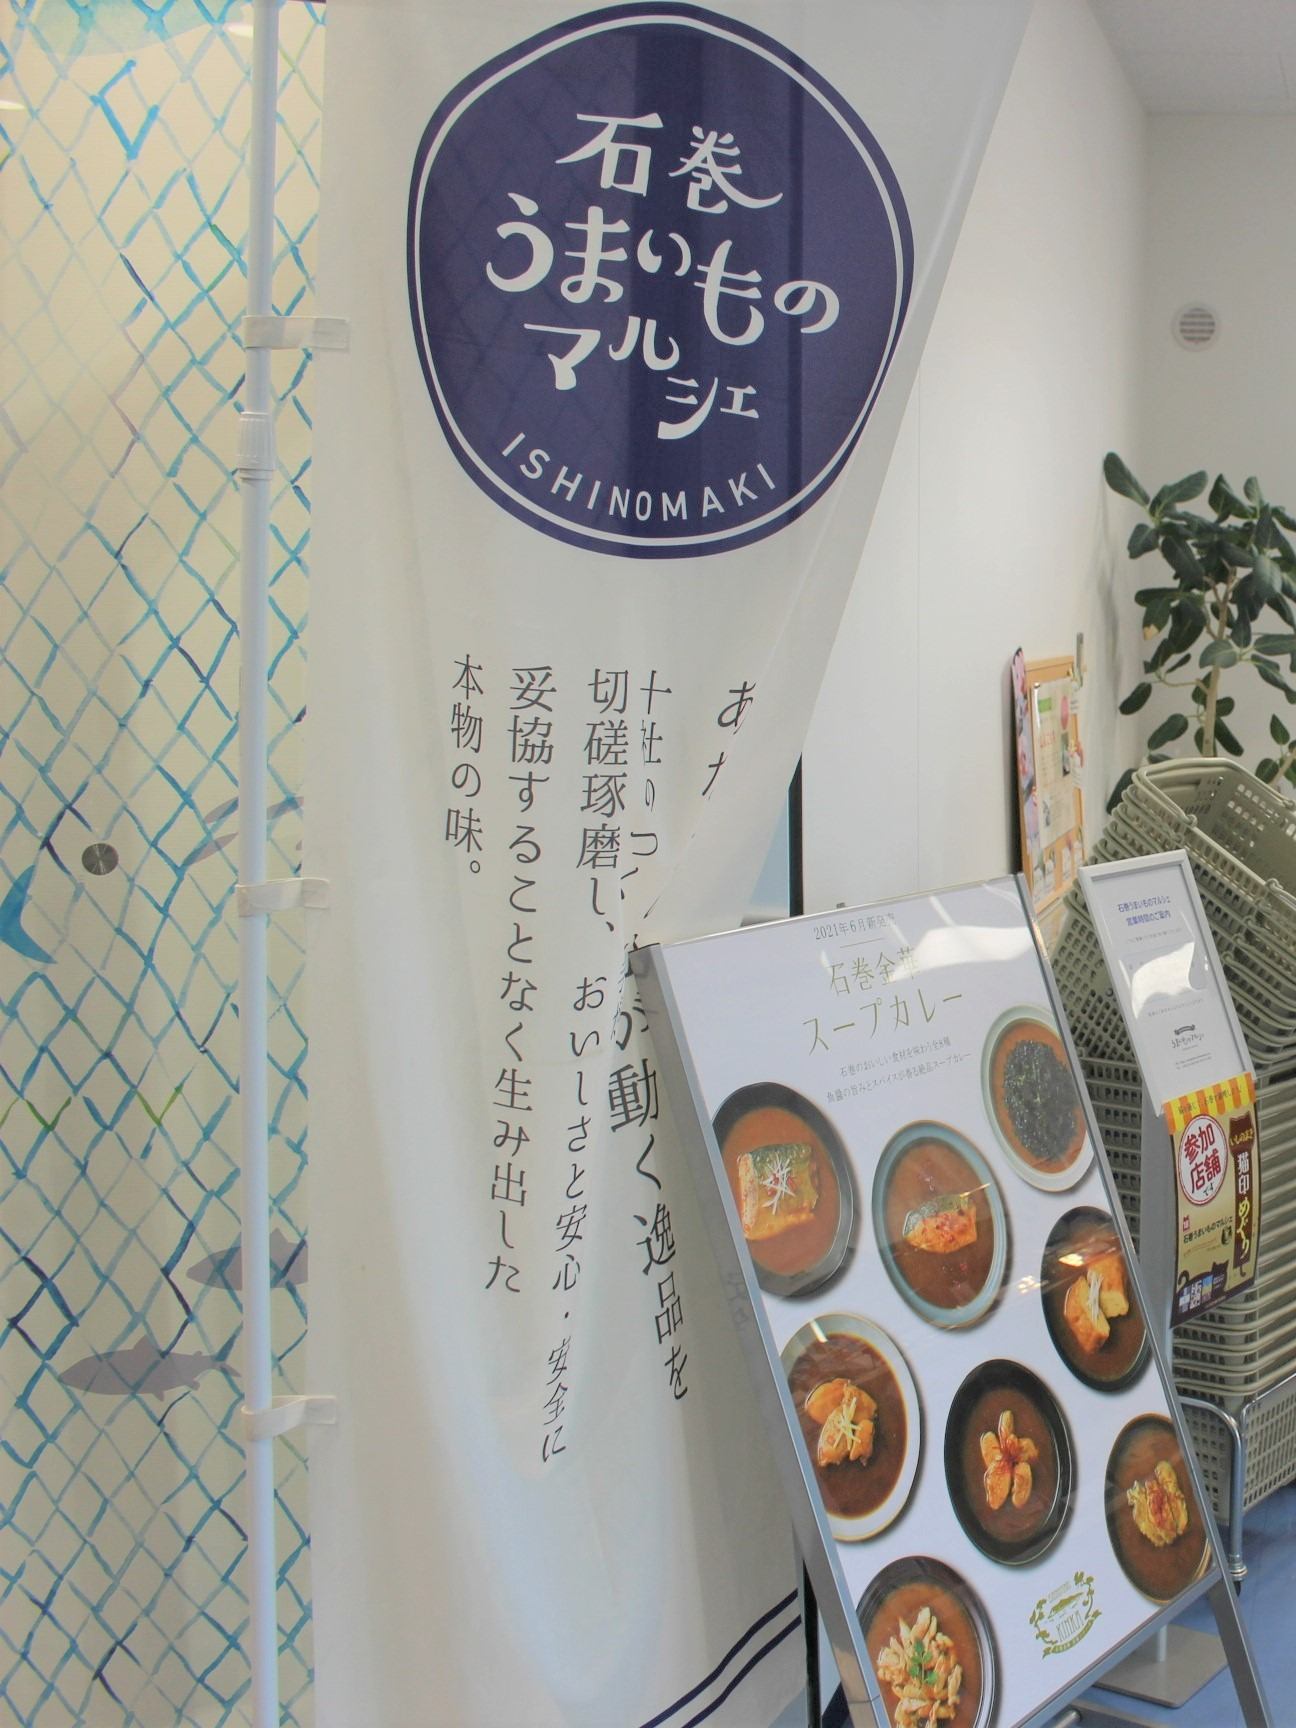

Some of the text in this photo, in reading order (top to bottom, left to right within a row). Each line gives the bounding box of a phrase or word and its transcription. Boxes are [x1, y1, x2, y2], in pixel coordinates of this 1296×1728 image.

[555, 111, 784, 214] 石巻
[484, 191, 841, 347] うまいもの
[523, 315, 760, 441] マルシェ
[501, 432, 778, 522] ISHINOMAKI
[444, 653, 484, 875] 本物の味。
[484, 665, 557, 1293] 妥協することなく生み出した
[802, 988, 963, 1056] スープカレー
[1184, 1123, 1215, 1165] 参加
[1190, 1147, 1222, 1194] 店舗
[1183, 1216, 1233, 1244] 石巻うまいものマルシェ
